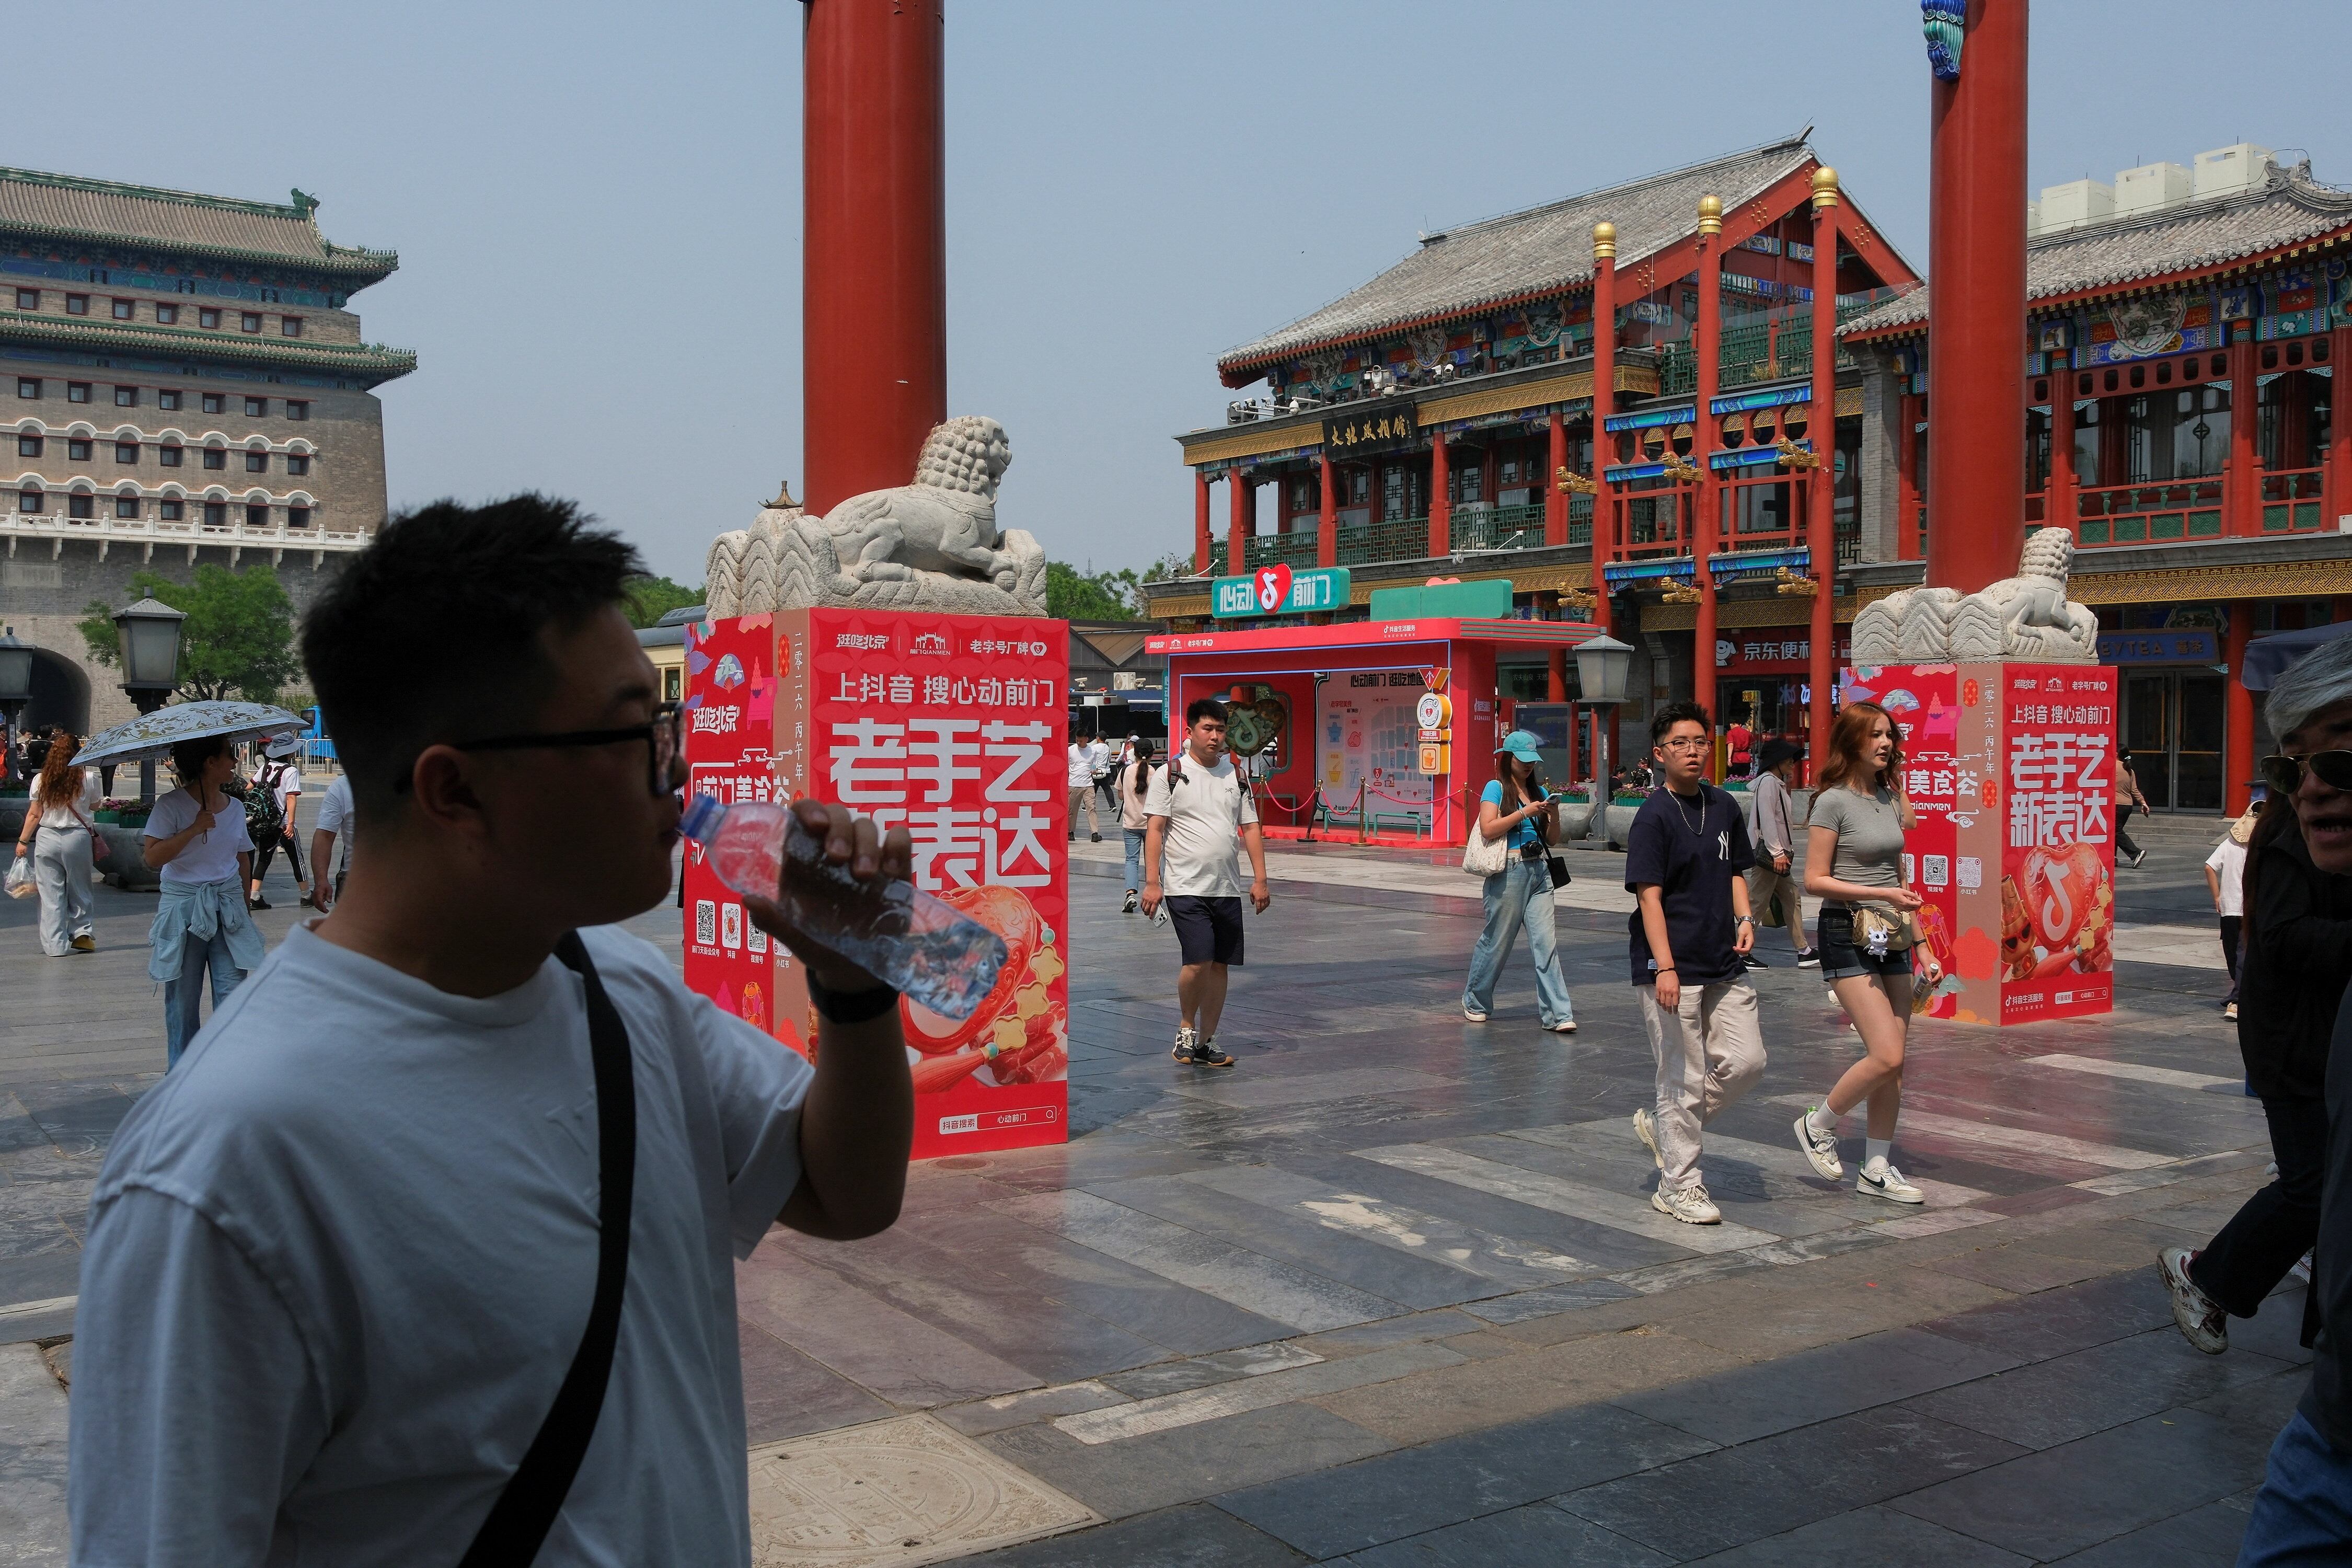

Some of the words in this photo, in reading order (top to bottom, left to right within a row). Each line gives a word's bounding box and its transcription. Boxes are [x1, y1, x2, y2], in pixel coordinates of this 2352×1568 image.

[1219, 582, 1254, 613] 心动
[1293, 574, 1330, 607] 前门
[836, 633, 887, 650] 逛吃北京
[970, 639, 1029, 655] 老字号厂牌
[1743, 640, 1836, 661] 京东便利
[2176, 639, 2204, 655] 喜茶
[794, 632, 803, 711] 二零二六
[1350, 673, 1386, 687] 心动前门
[1389, 672, 1425, 686] 逛吃地图
[830, 672, 915, 705] 上抖音
[923, 675, 1054, 707] 搜心动前门
[2014, 679, 2037, 689] 逛吃北京
[2072, 681, 2099, 691] 老字号厂牌
[1984, 677, 1996, 730] 二零二六
[691, 705, 738, 735] 逛吃北京
[2011, 704, 2048, 724] 上抖音
[2051, 705, 2110, 725] 搜心动前门
[794, 721, 803, 782] 丙午年
[829, 718, 1052, 803] 老手艺
[1985, 735, 1996, 775] 丙午年
[2011, 732, 2109, 789] 老手艺
[2010, 790, 2108, 847] 新表达
[848, 806, 1051, 890] 表达
[691, 945, 720, 957] 前门天街公众号
[727, 950, 736, 959] 抖音
[751, 954, 764, 964] 视频号
[776, 958, 790, 969] 小红书
[2012, 993, 2044, 1005] 抖音生活服务
[942, 1118, 975, 1131] 抖音搜索
[997, 1113, 1027, 1124] 心动前门
